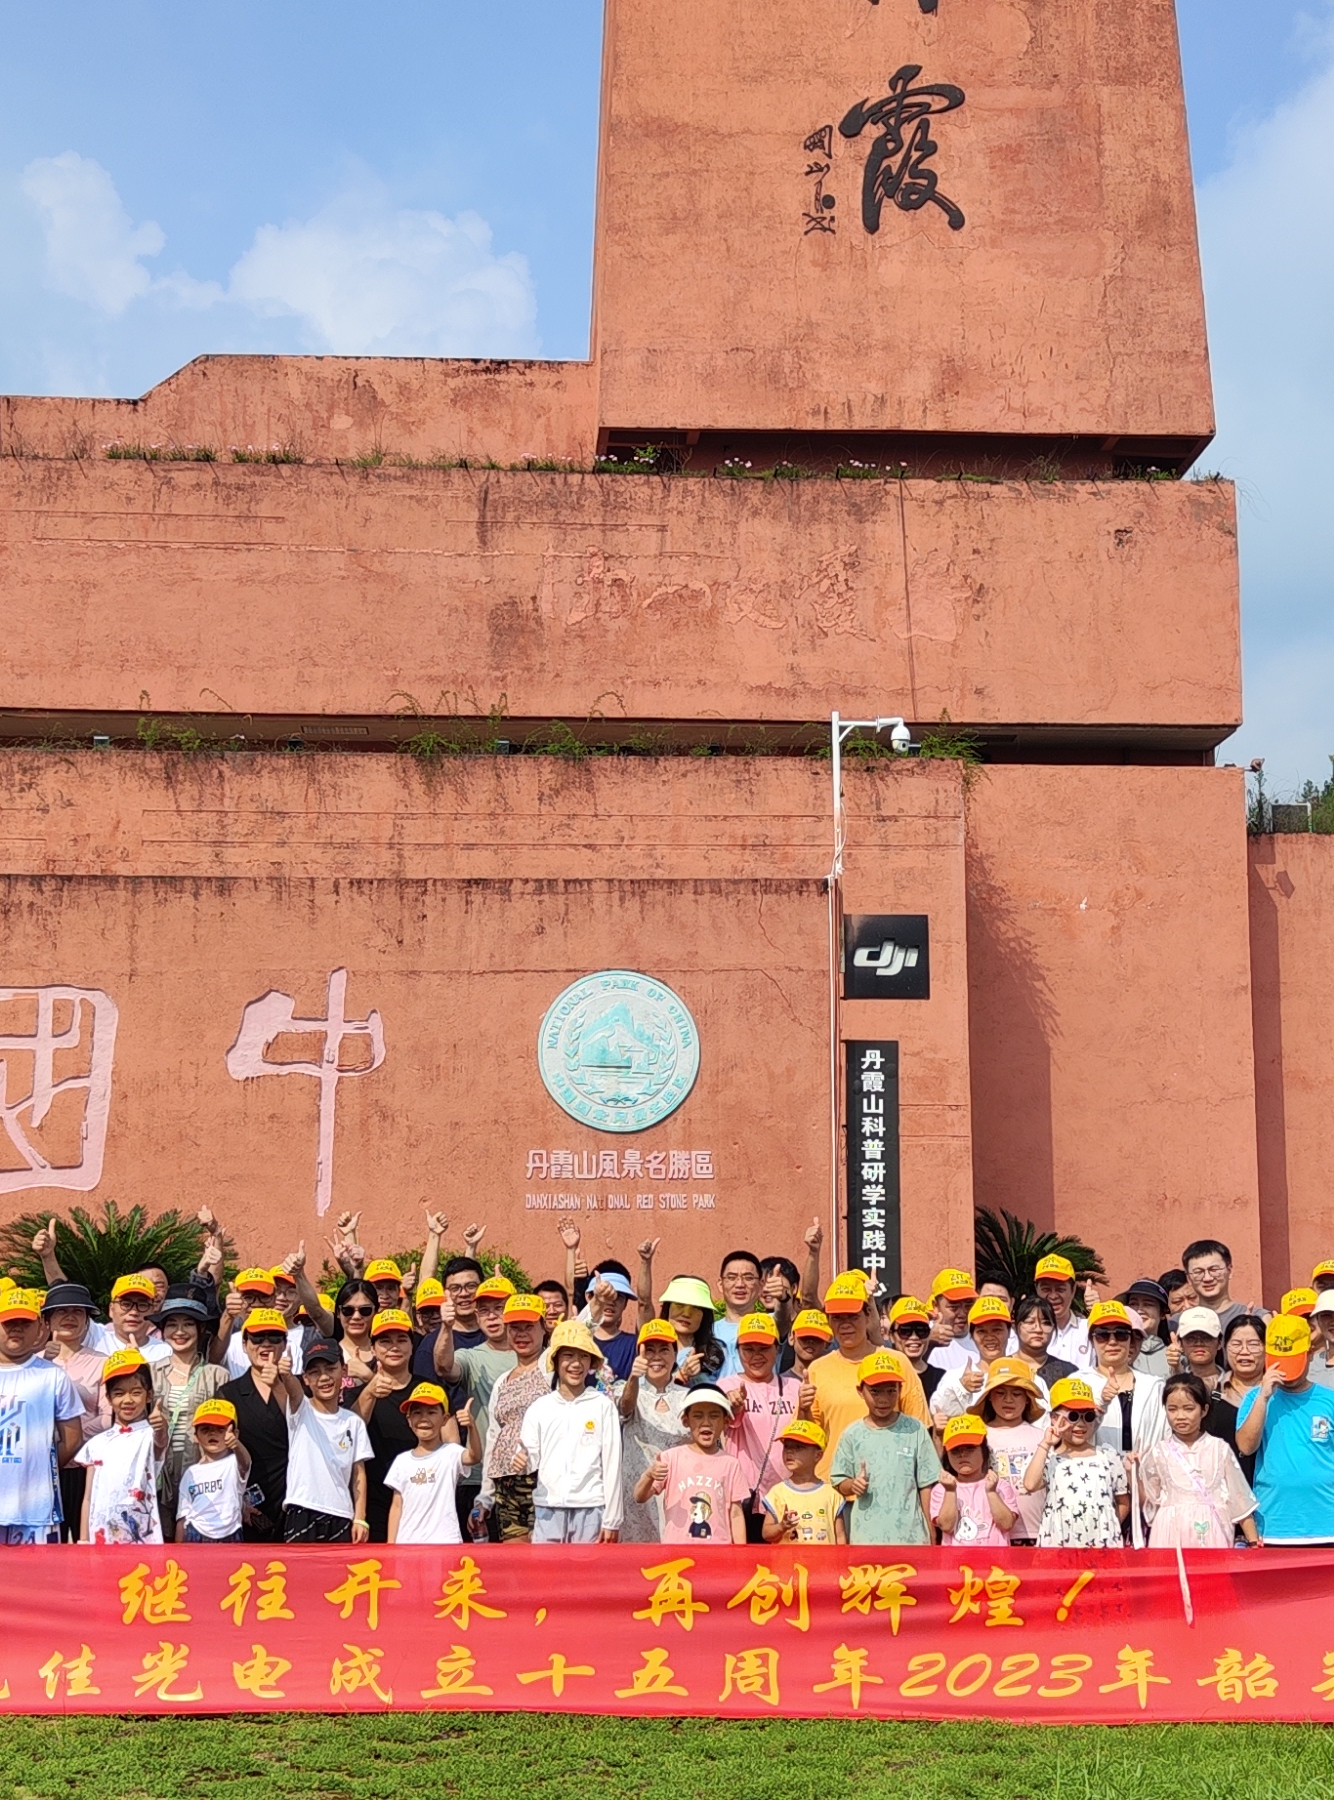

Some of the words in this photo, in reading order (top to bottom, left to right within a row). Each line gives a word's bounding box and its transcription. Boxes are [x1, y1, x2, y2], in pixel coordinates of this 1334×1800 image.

[838, 0, 965, 234] 霞
[547, 988, 594, 1049] NATIONAL
[600, 979, 641, 991] PARK
[646, 988, 666, 1002] OF
[667, 1004, 692, 1049] CHINA
[526, 1149, 715, 1180] 丹霞山風景名勝區
[525, 1193, 581, 1210] DANXIASHAN
[586, 1193, 631, 1210] NAONAL
[636, 1193, 654, 1210] RED
[658, 1193, 688, 1210] STONE
[692, 1193, 716, 1210] PARK
